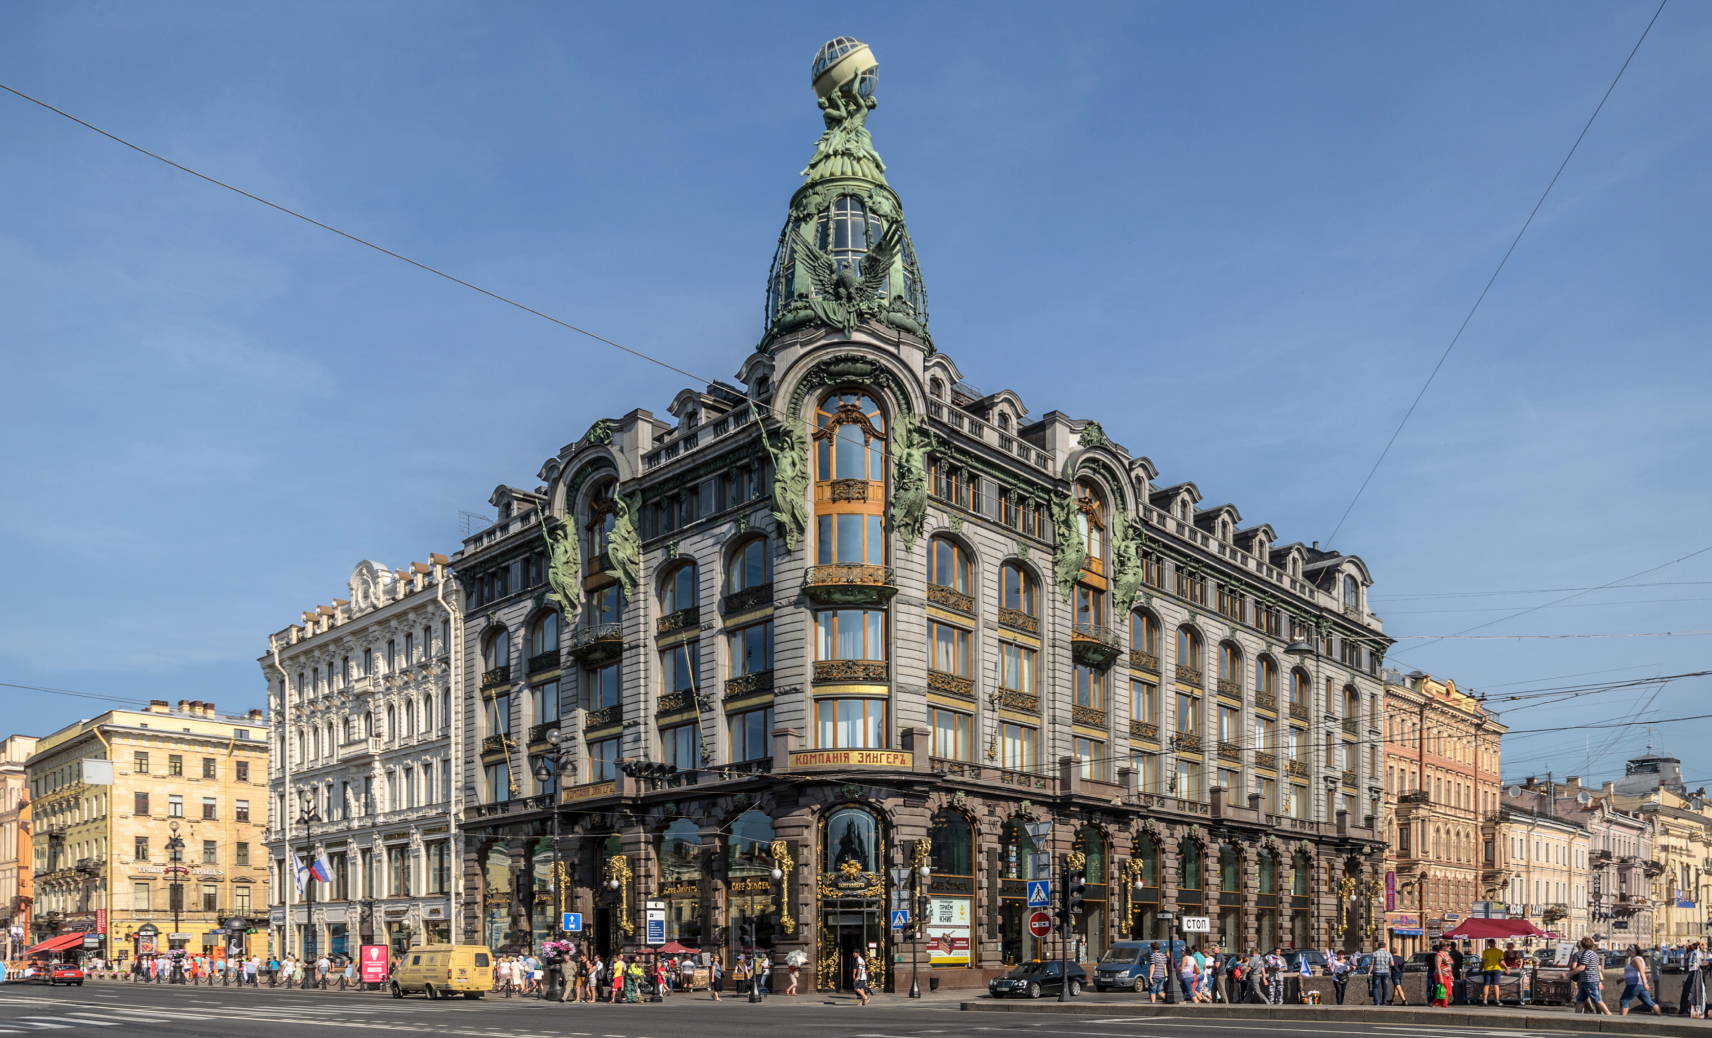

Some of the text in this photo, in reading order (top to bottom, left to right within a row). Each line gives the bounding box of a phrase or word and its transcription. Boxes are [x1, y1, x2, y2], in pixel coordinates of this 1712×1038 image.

[795, 752, 906, 765] КОМПАНІЯ ЗИНГЕРЪ
[1509, 903, 1524, 915] КОФЕ
[1187, 919, 1206, 929] СТОП
